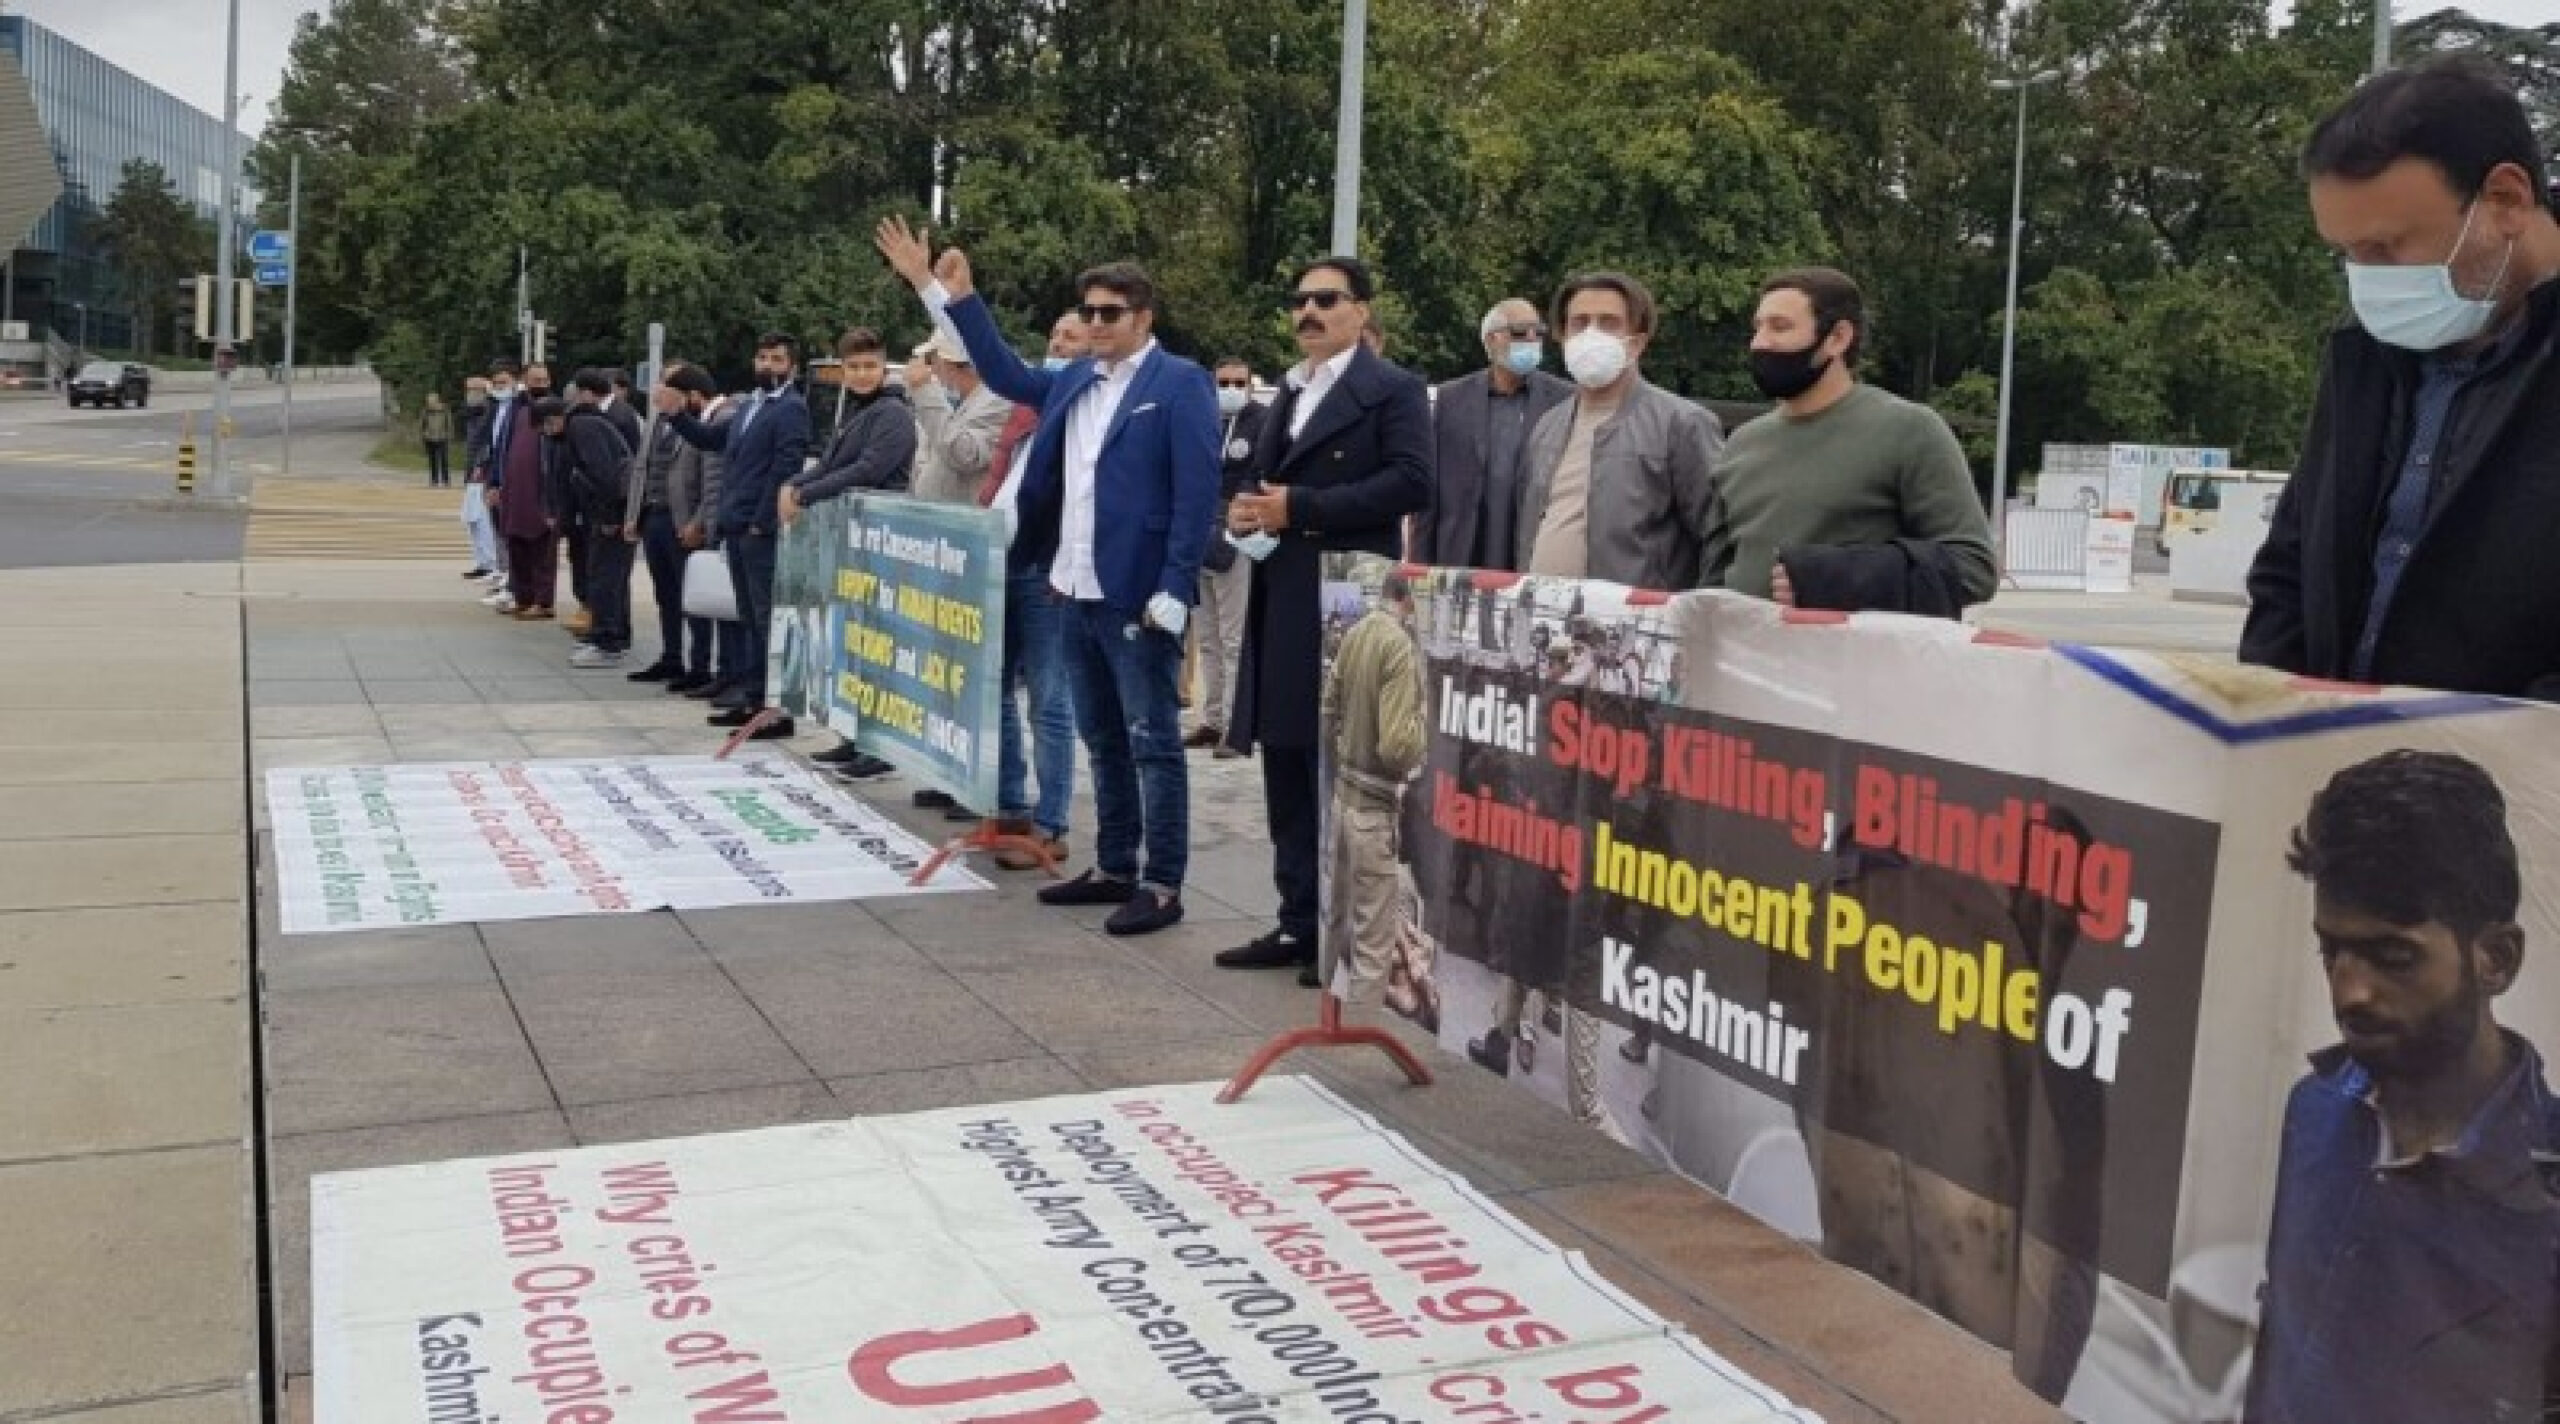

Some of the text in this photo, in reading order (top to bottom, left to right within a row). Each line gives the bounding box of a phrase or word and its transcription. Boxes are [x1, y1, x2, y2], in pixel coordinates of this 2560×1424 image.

[1439, 674, 2149, 948] India! Stop Killing, Blinding,
[1593, 821, 1813, 960] Innocent
[1823, 892, 2040, 1042] People
[2044, 987, 2133, 1084] of
[1601, 936, 1809, 1086] Kashmir
[486, 1163, 574, 1258] Indian
[594, 1160, 680, 1224] Why
[626, 1234, 717, 1321] cries
[1172, 1243, 1249, 1269] of
[1249, 1222, 1423, 1339] Kashmir
[1291, 1167, 1569, 1350] Killings
[664, 1329, 762, 1368] of
